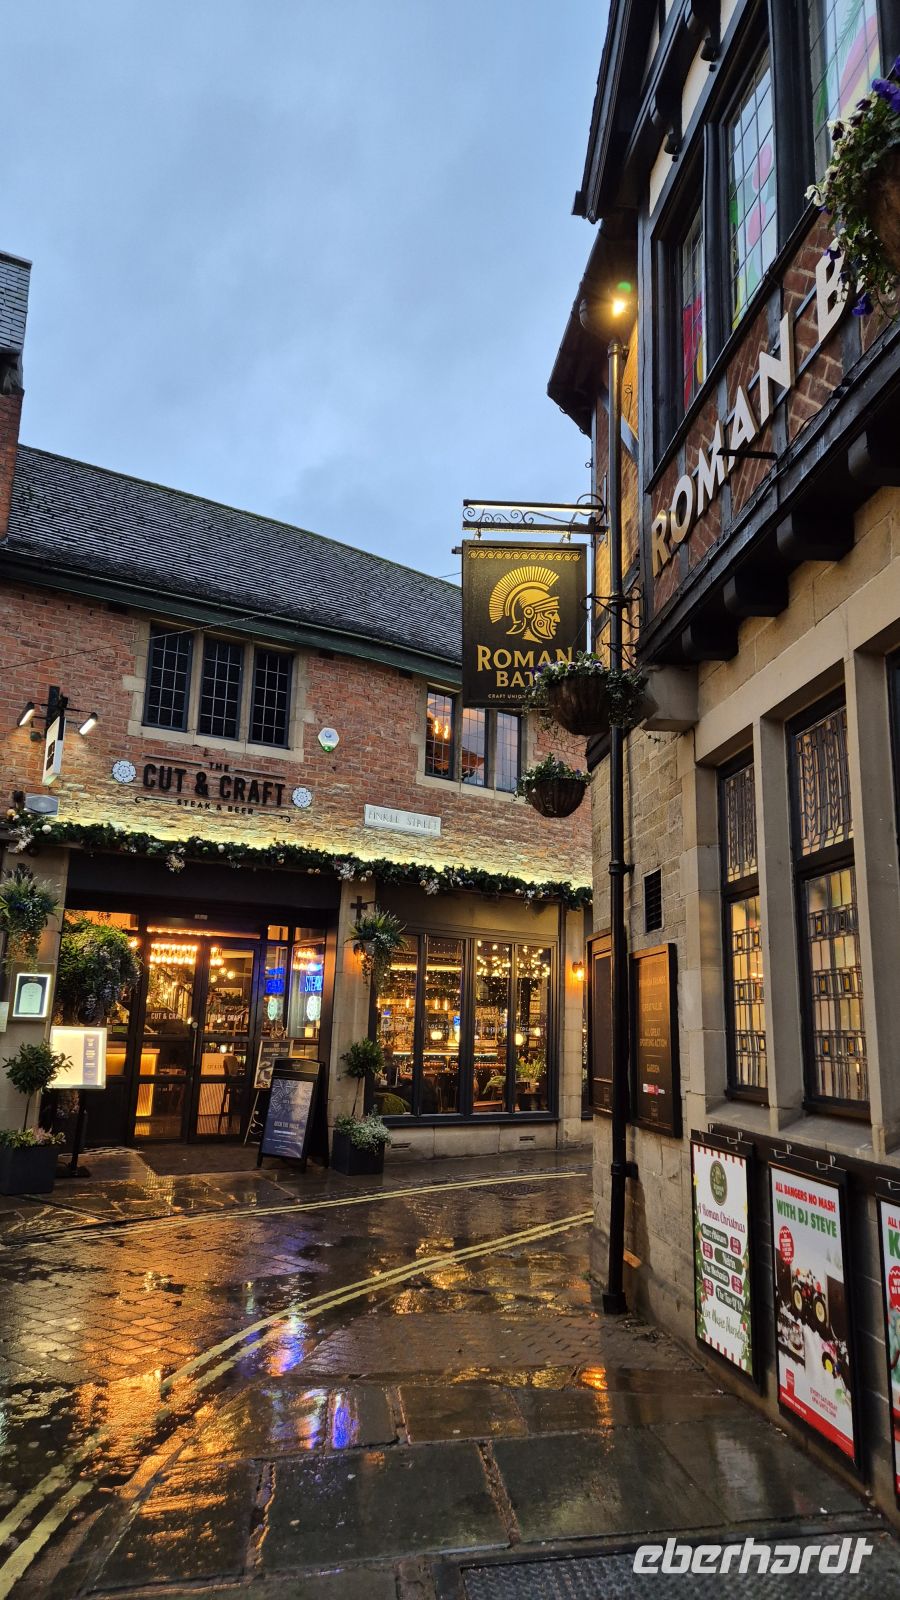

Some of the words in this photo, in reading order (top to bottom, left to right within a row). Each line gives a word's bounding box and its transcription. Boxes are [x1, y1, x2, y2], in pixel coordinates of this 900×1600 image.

[651, 311, 795, 578] ROMAN
[477, 644, 573, 672] ROMAN
[496, 670, 535, 688] BAT
[209, 761, 230, 772] THE
[143, 763, 187, 793] CUT
[195, 771, 209, 797] &
[219, 775, 286, 807] CRAFT
[177, 799, 211, 810] STEAK
[227, 806, 254, 815] BEER
[784, 1185, 807, 1202] BANGERS
[809, 1193, 817, 1205] NO
[819, 1197, 836, 1213] MASH
[702, 1203, 720, 1222] Roman
[720, 1210, 745, 1234] Christmas
[776, 1199, 796, 1221] WITH
[798, 1207, 808, 1226] DJ
[811, 1212, 837, 1238] STEVE
[888, 1216, 898, 1229] ALL
